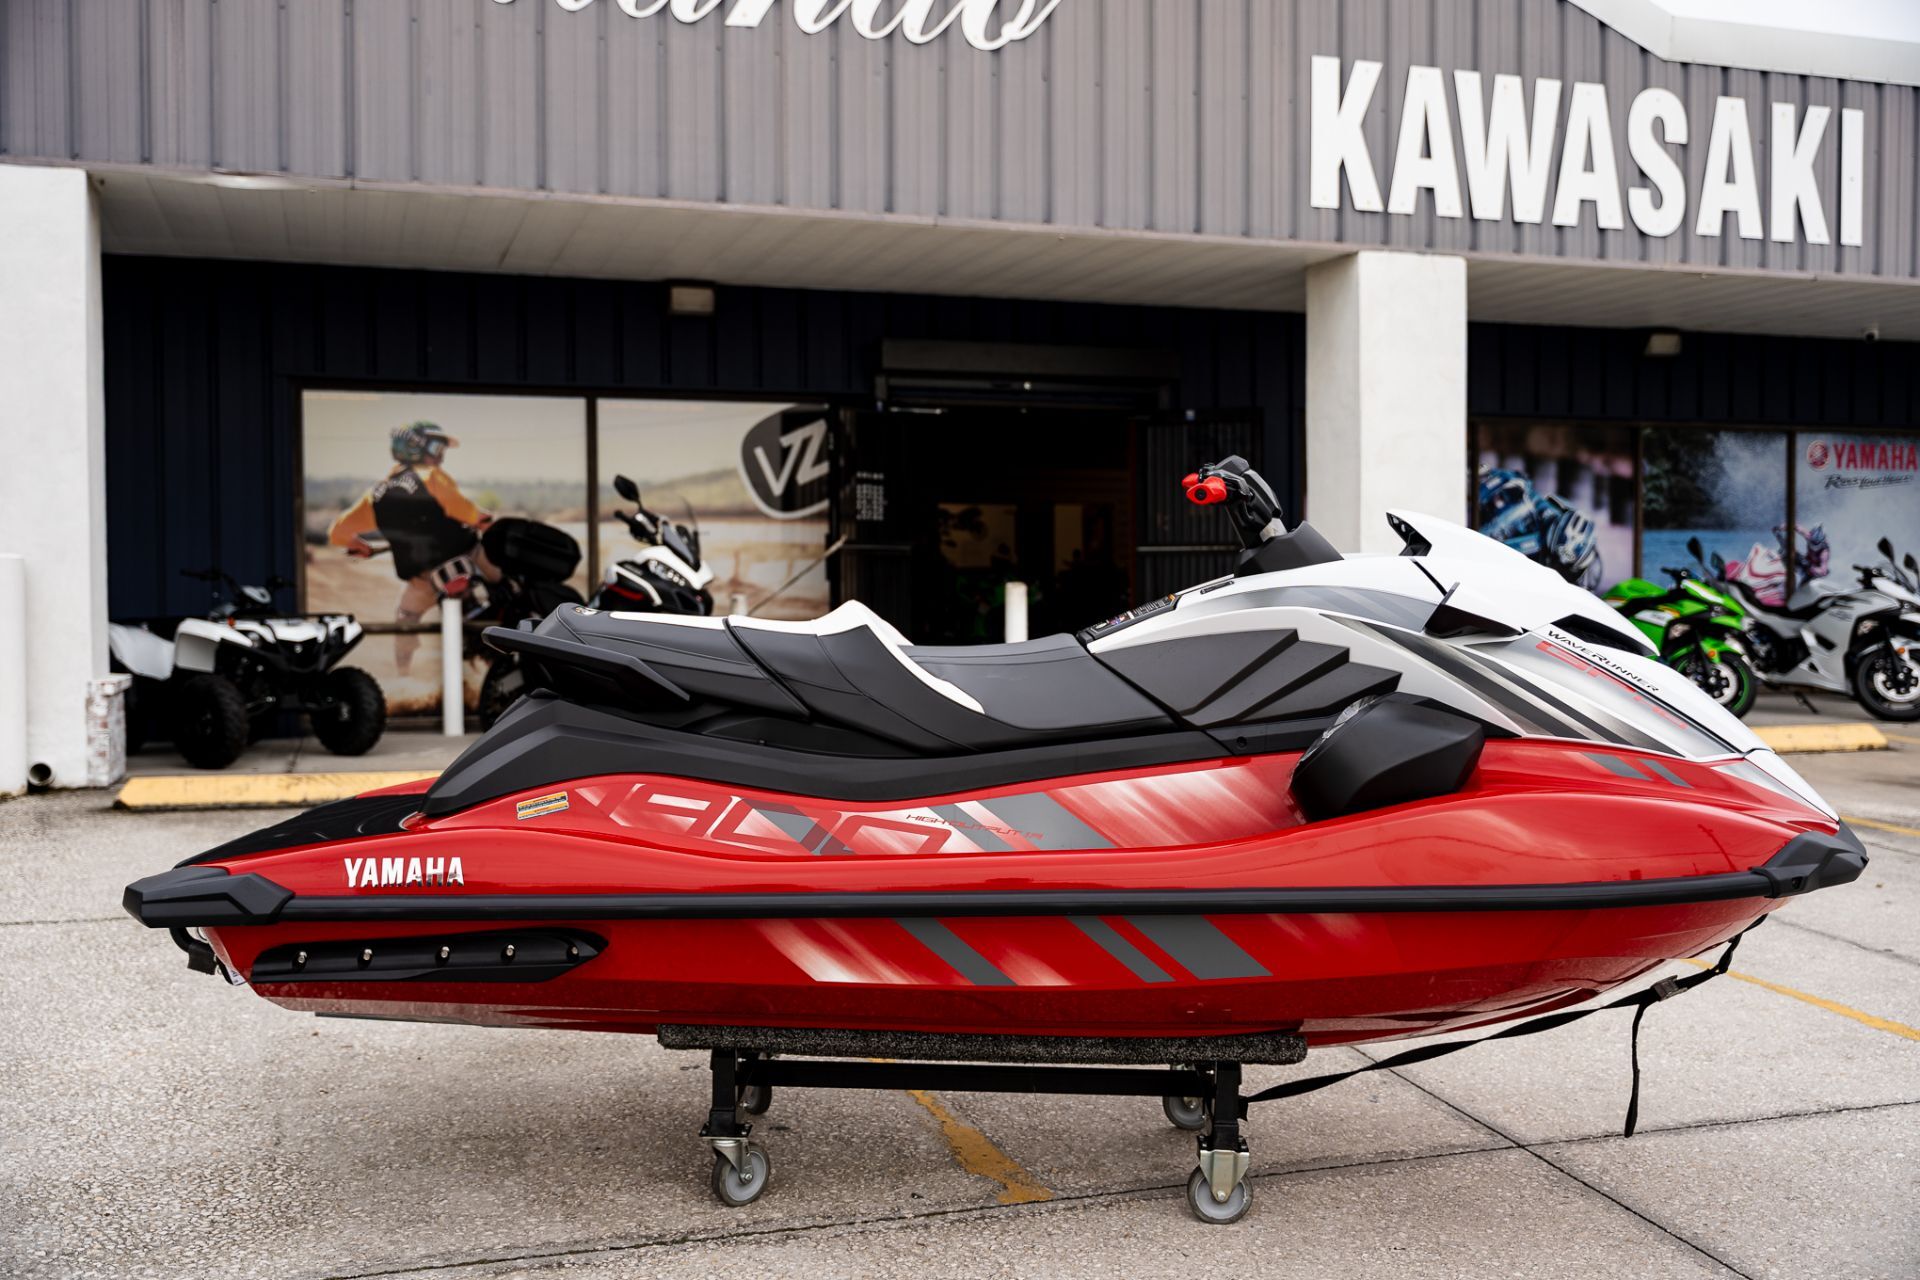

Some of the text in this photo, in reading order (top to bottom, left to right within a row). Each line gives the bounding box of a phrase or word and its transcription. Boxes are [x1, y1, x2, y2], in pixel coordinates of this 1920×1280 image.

[1310, 54, 1865, 247] KAWASAKI
[1832, 442, 1918, 471] YAMAHA
[905, 813, 948, 826] HIGH
[343, 856, 465, 888] YAMAHA
